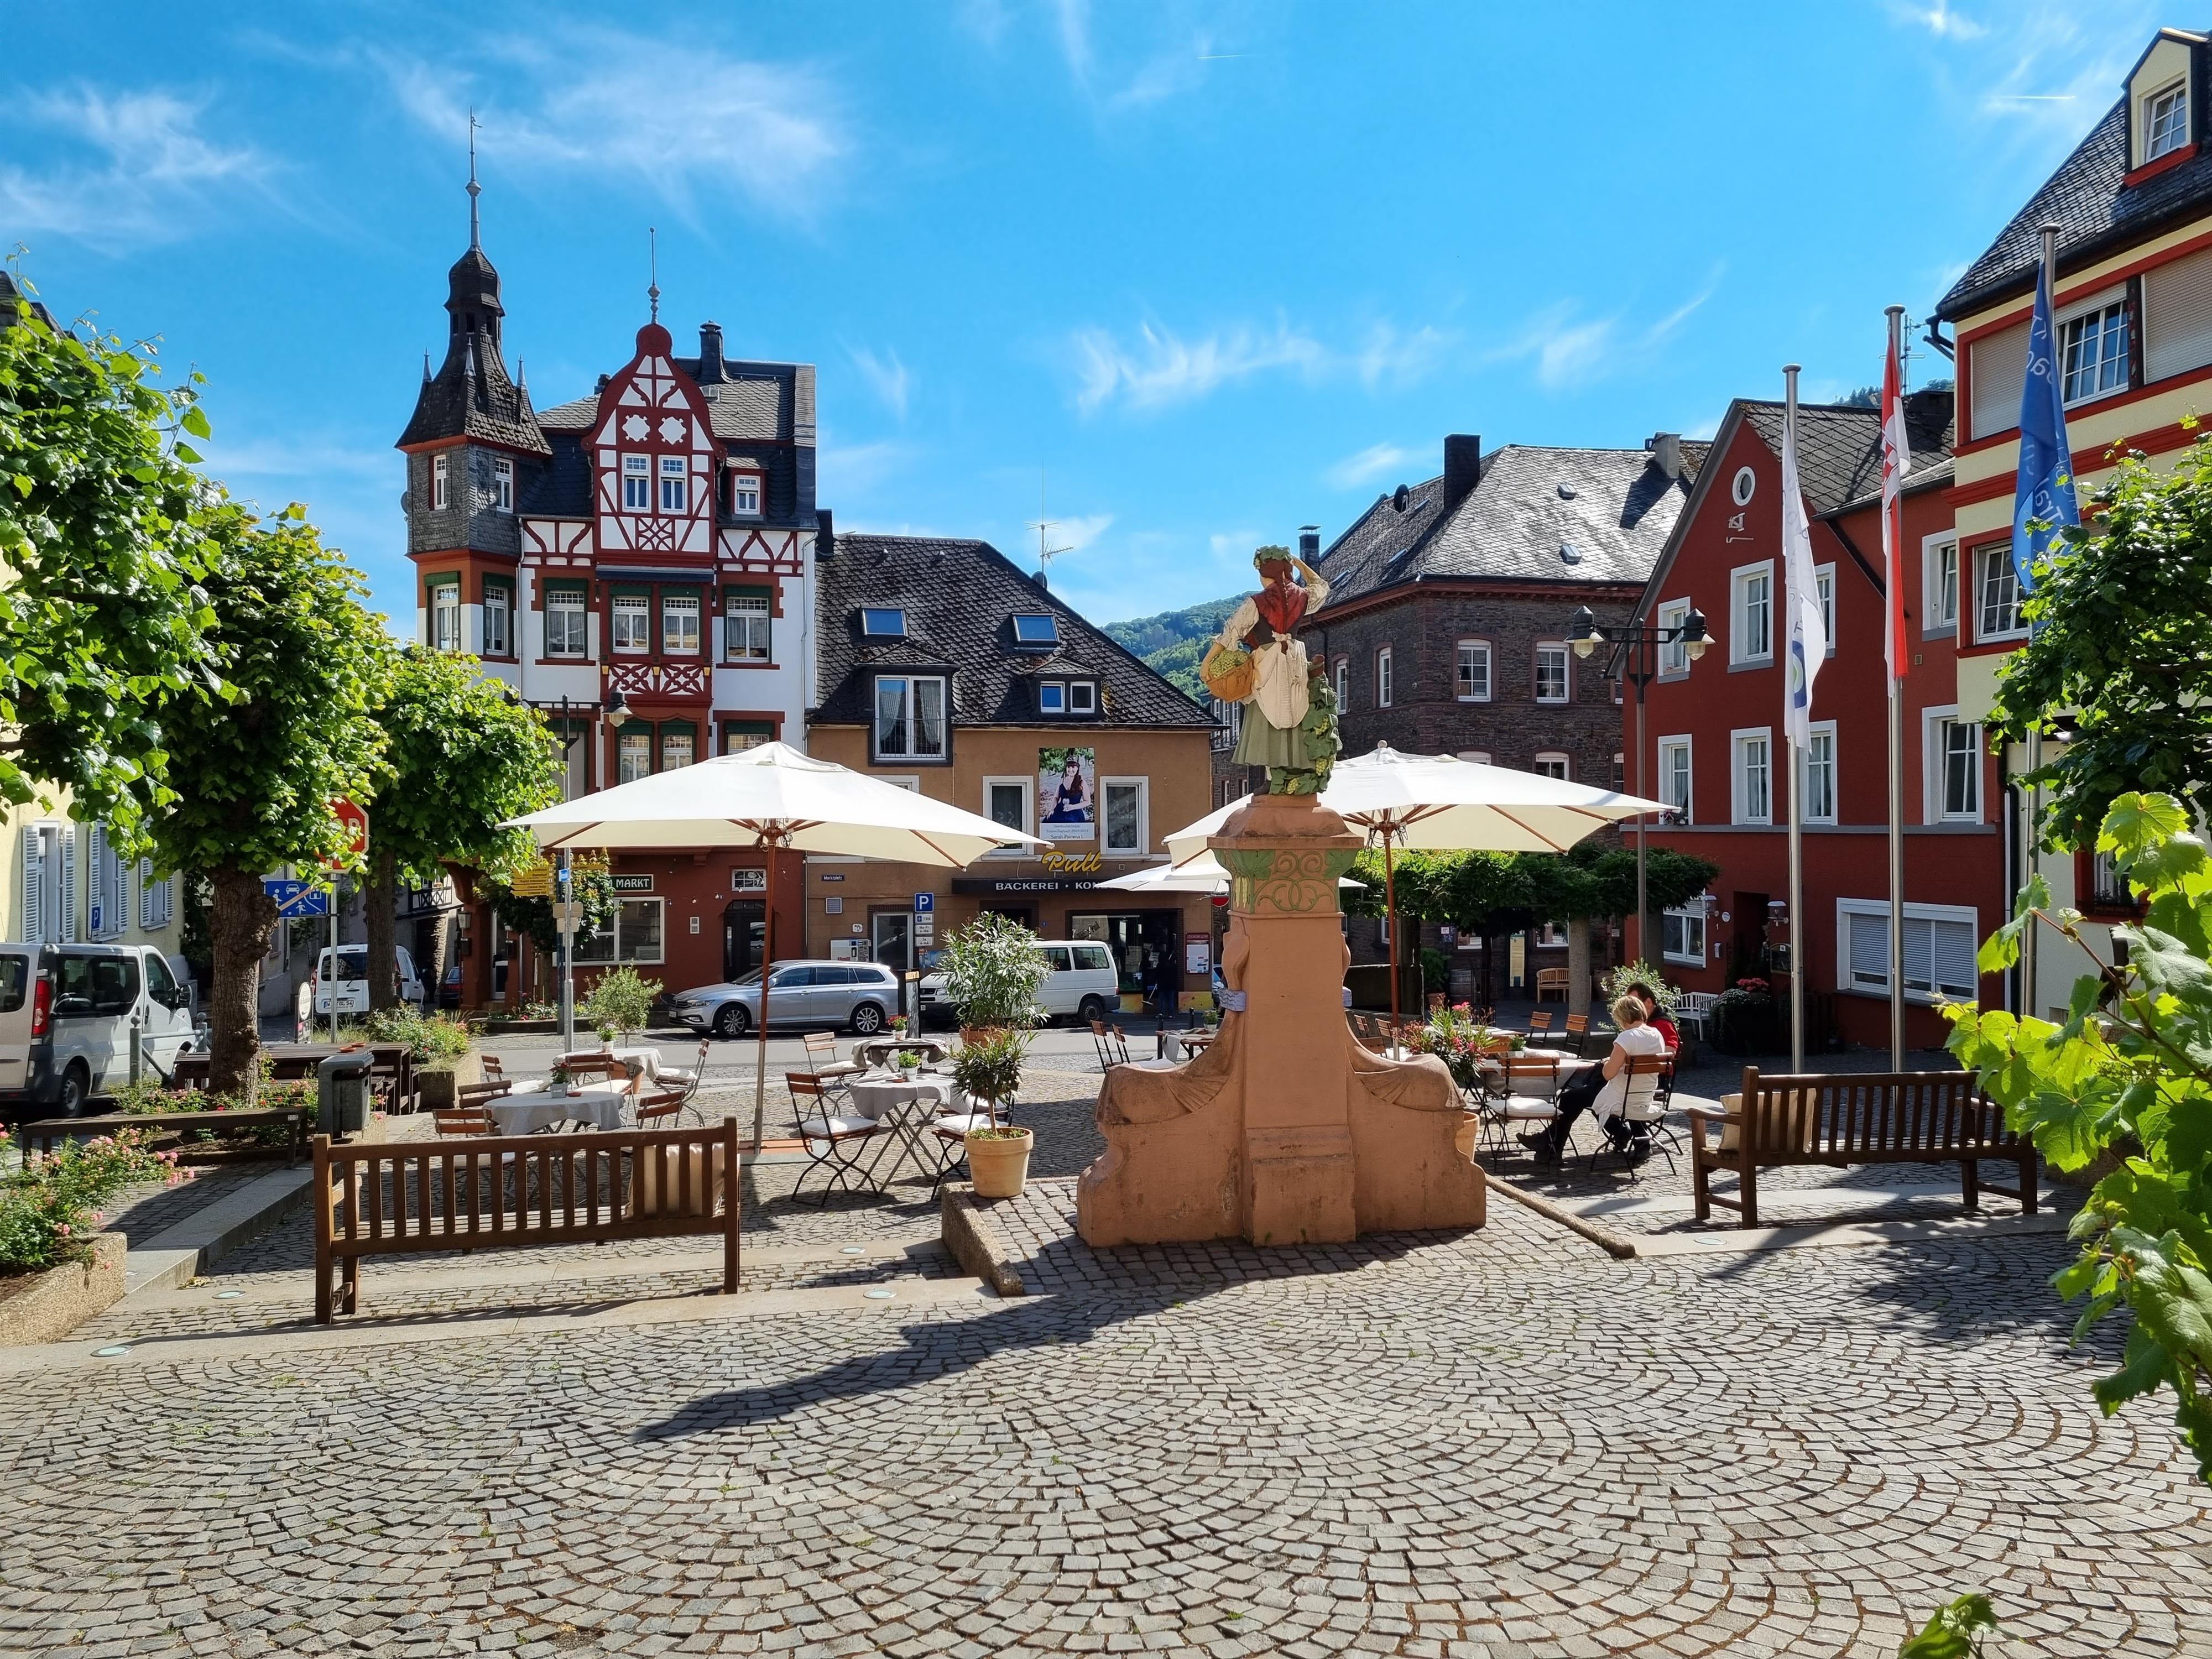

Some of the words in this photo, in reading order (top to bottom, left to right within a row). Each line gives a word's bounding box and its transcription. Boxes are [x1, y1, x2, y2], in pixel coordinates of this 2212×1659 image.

[615, 878, 649, 888] MARKT
[995, 881, 1058, 890] BÄCKEREI
[919, 896, 929, 910] P
[93, 910, 98, 926] P
